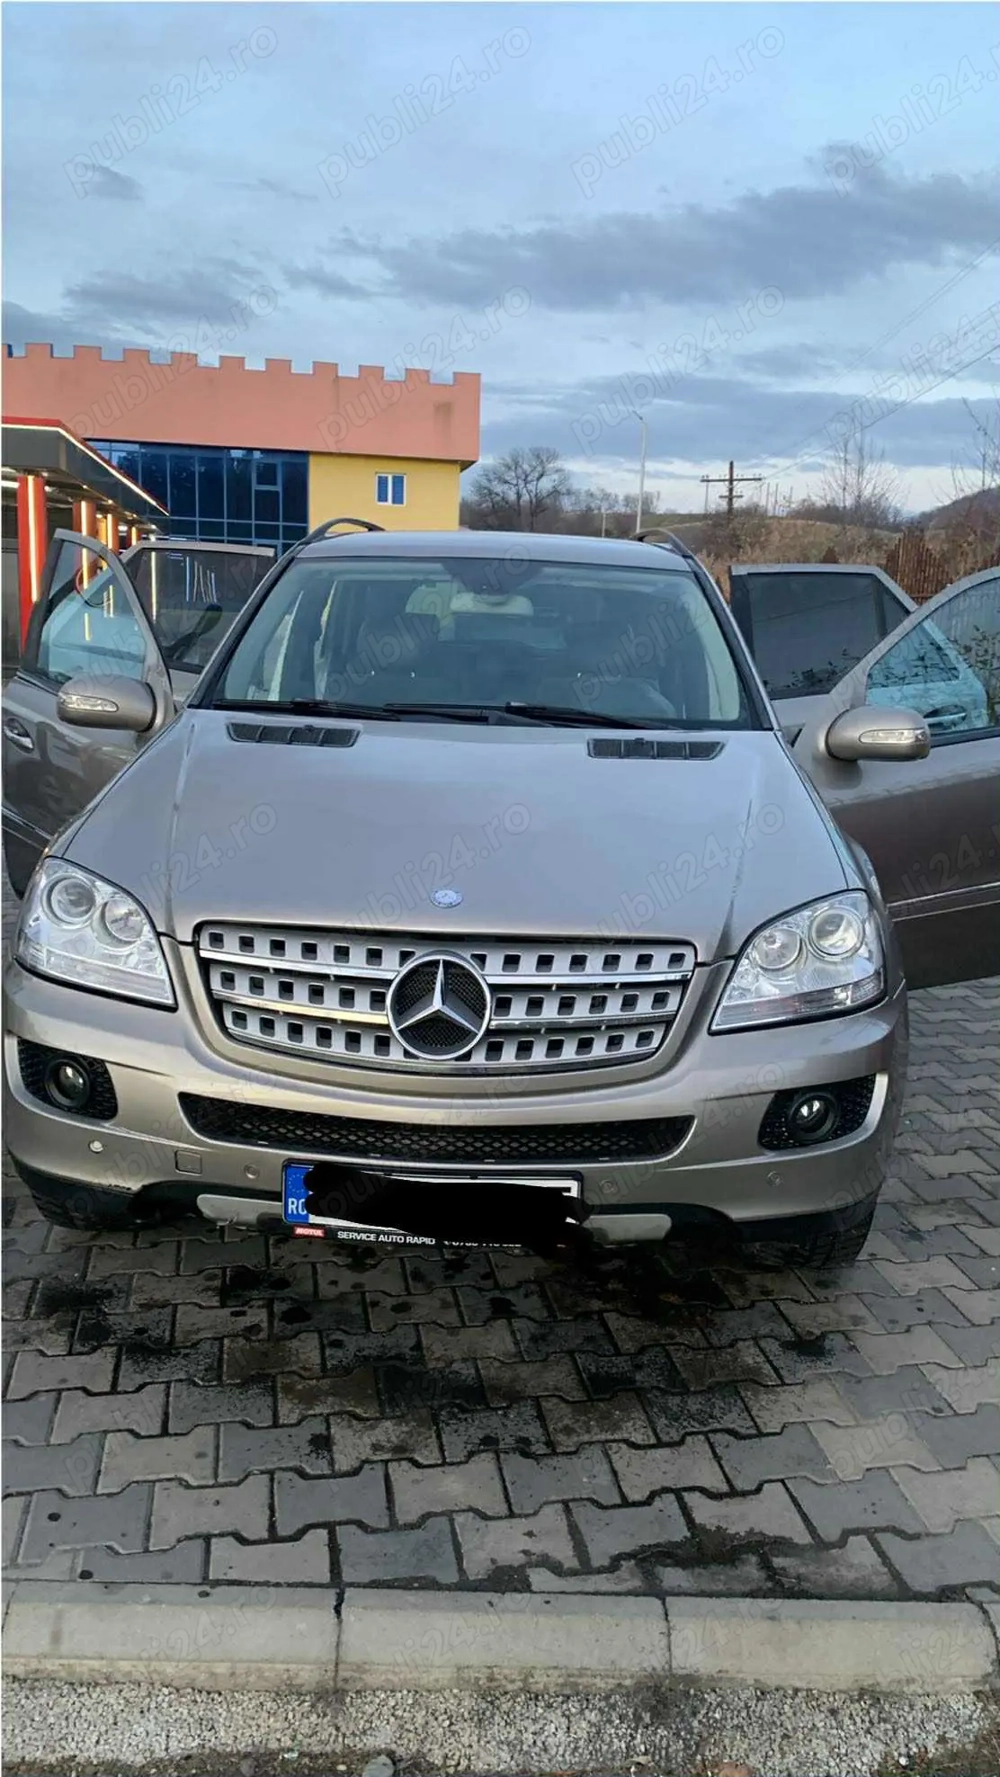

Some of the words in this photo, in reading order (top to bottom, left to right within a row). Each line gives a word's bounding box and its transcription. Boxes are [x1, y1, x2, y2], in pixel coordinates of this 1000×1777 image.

[337, 1230, 377, 1242] SERVICE
[378, 1234, 405, 1243] AUTO
[406, 1236, 436, 1246] RAPID
